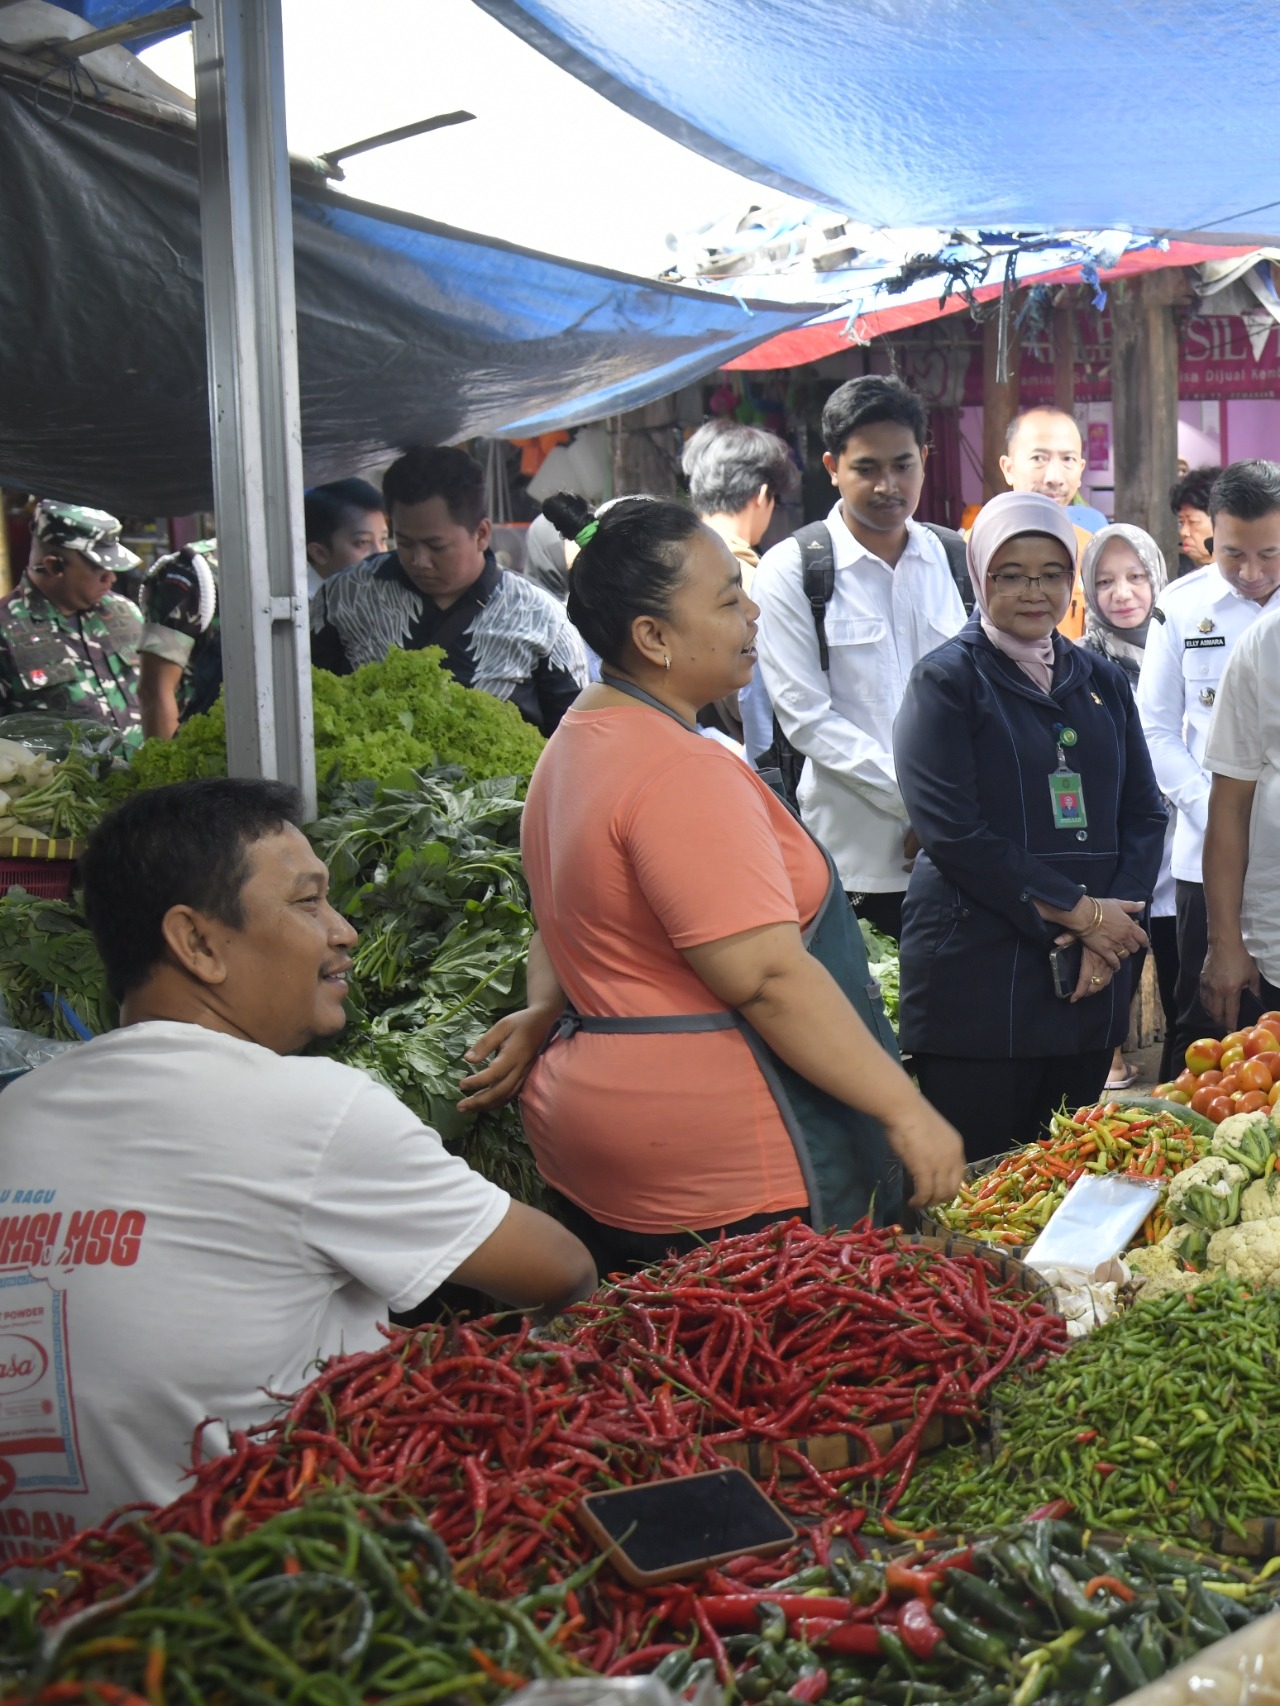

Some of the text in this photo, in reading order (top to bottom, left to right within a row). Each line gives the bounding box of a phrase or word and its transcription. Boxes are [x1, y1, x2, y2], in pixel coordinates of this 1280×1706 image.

[1178, 371, 1198, 382] isa
[1186, 640, 1200, 648] ELLY
[12, 1189, 57, 1205] RAGU
[56, 1208, 147, 1267] MSG
[4, 1306, 45, 1321] POWDER
